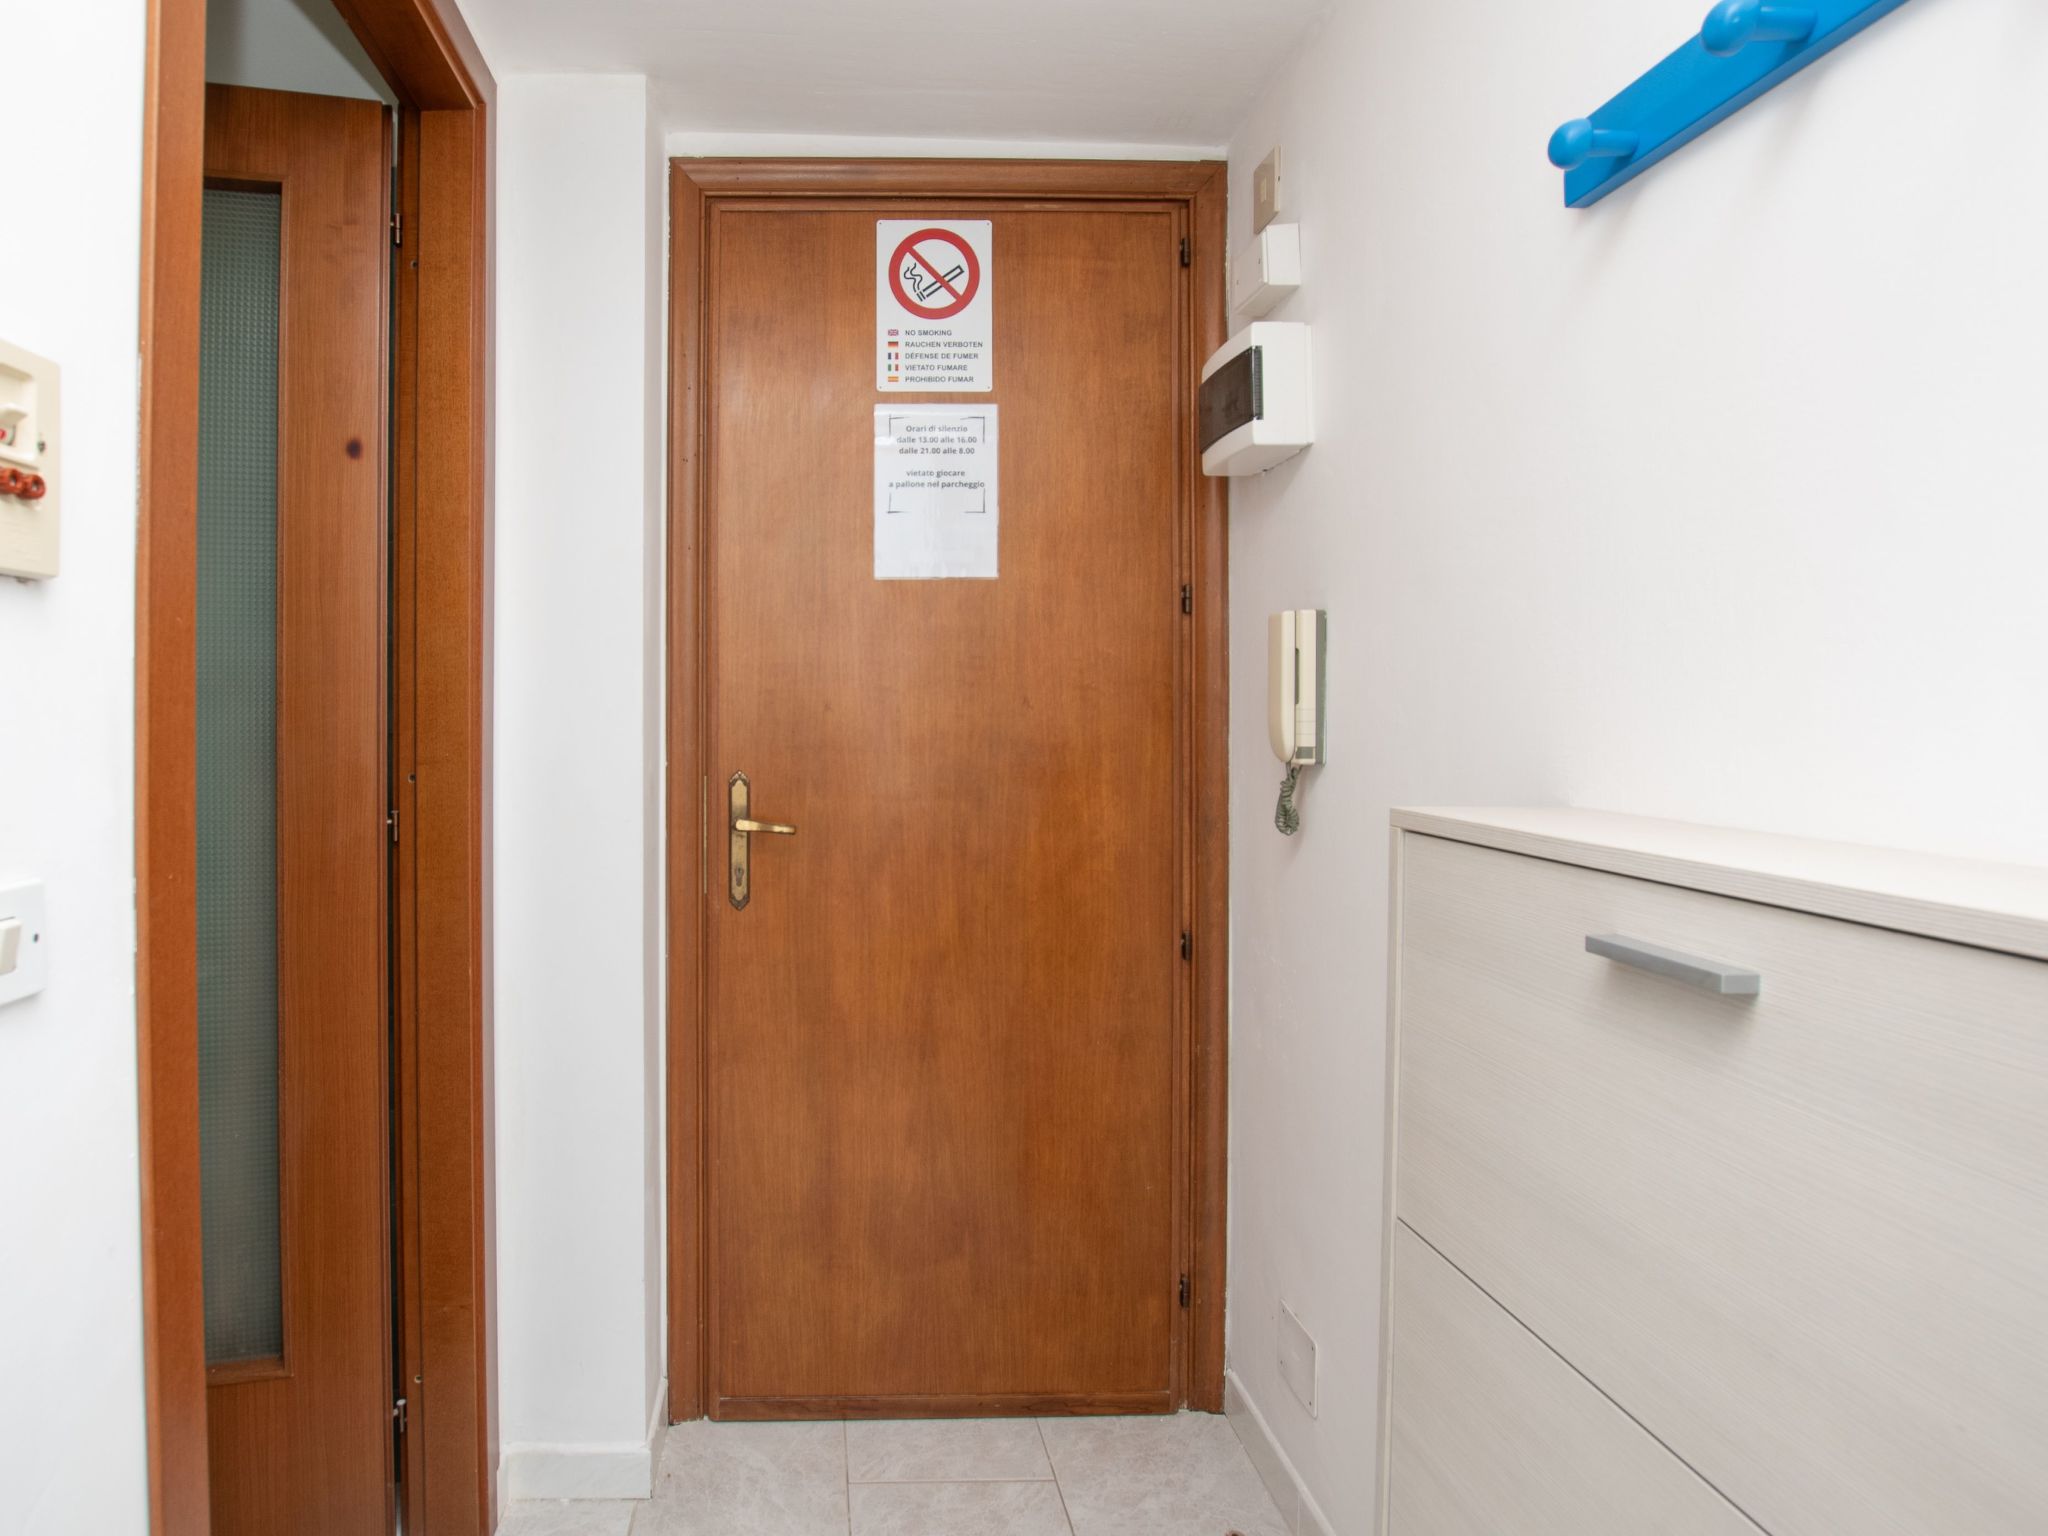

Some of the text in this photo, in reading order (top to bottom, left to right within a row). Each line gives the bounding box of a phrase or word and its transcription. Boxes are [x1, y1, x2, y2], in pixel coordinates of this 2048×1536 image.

[905, 424, 968, 433] Orari di silenzio
[896, 436, 916, 444] dalle
[918, 436, 938, 444] 13.00
[940, 436, 955, 444] alle
[899, 447, 975, 455] dalle 21.00 alle 8.00
[906, 469, 966, 479] vietato giocare
[895, 480, 925, 490] pallone
[927, 480, 940, 488] nel
[941, 480, 985, 490] parcheggio
